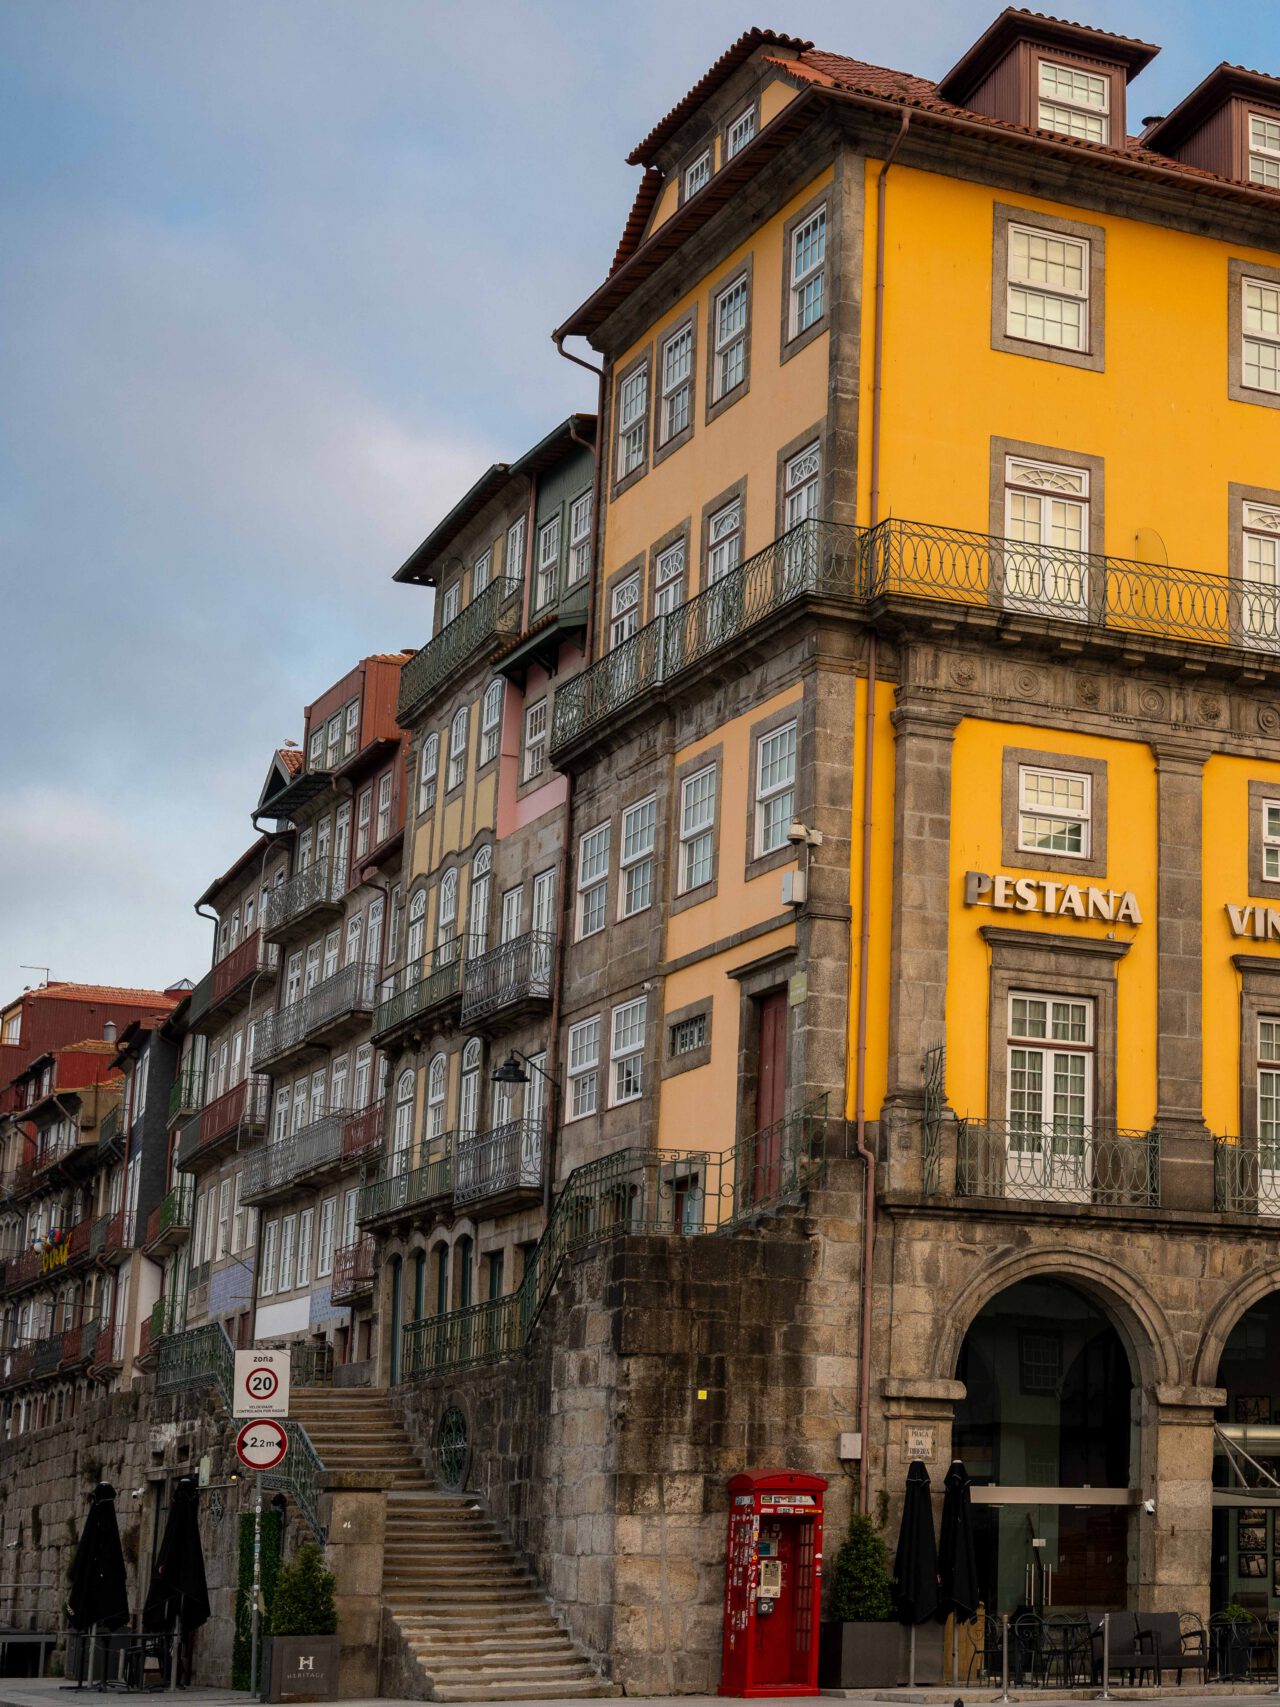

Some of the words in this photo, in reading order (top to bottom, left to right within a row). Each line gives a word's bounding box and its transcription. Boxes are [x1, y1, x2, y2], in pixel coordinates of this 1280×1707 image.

[965, 870, 1143, 924] PESTANA
[253, 1355, 274, 1363] zona
[252, 1376, 273, 1391] 20
[298, 1656, 314, 1670] H
